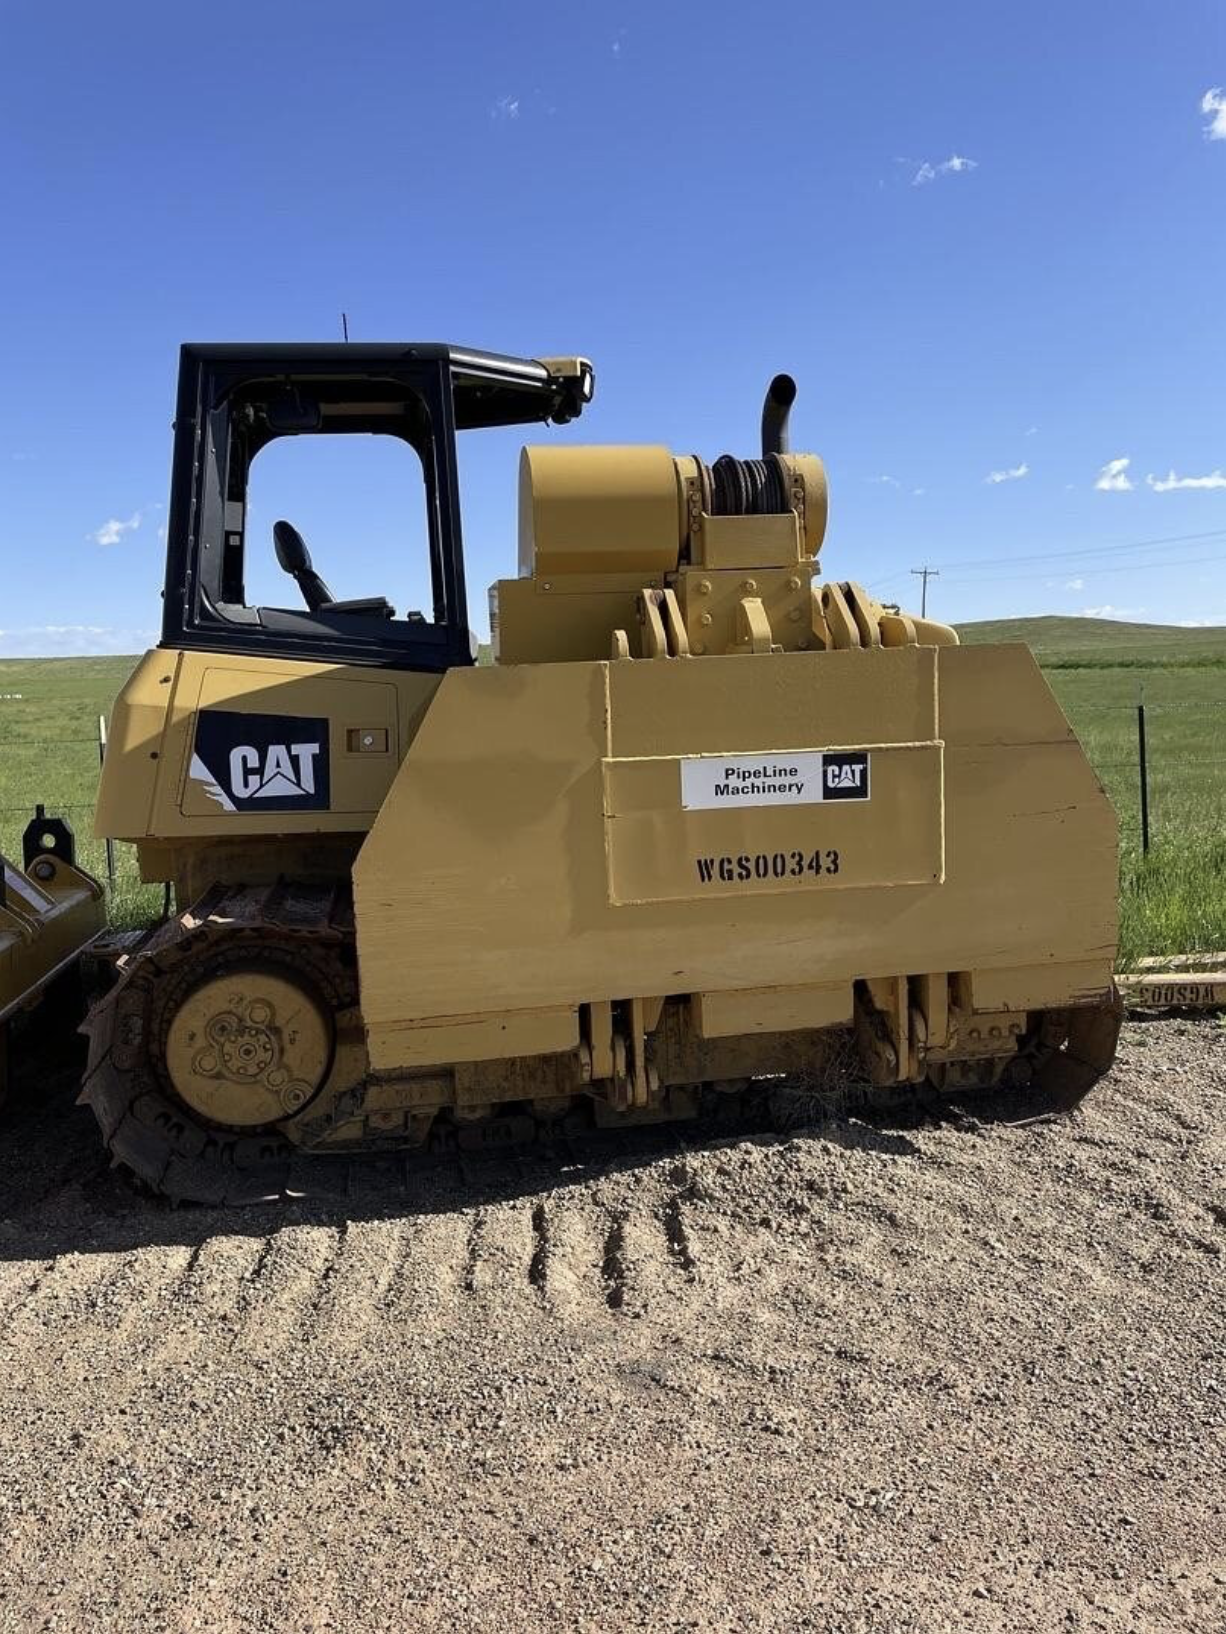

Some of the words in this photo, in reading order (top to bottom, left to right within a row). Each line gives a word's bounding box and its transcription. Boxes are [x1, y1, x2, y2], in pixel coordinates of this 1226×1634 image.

[229, 743, 320, 799] CAT
[724, 766, 798, 782] PipeLine
[827, 764, 864, 788] CAT
[714, 781, 804, 797] Machinery
[697, 850, 840, 882] WGS00343
